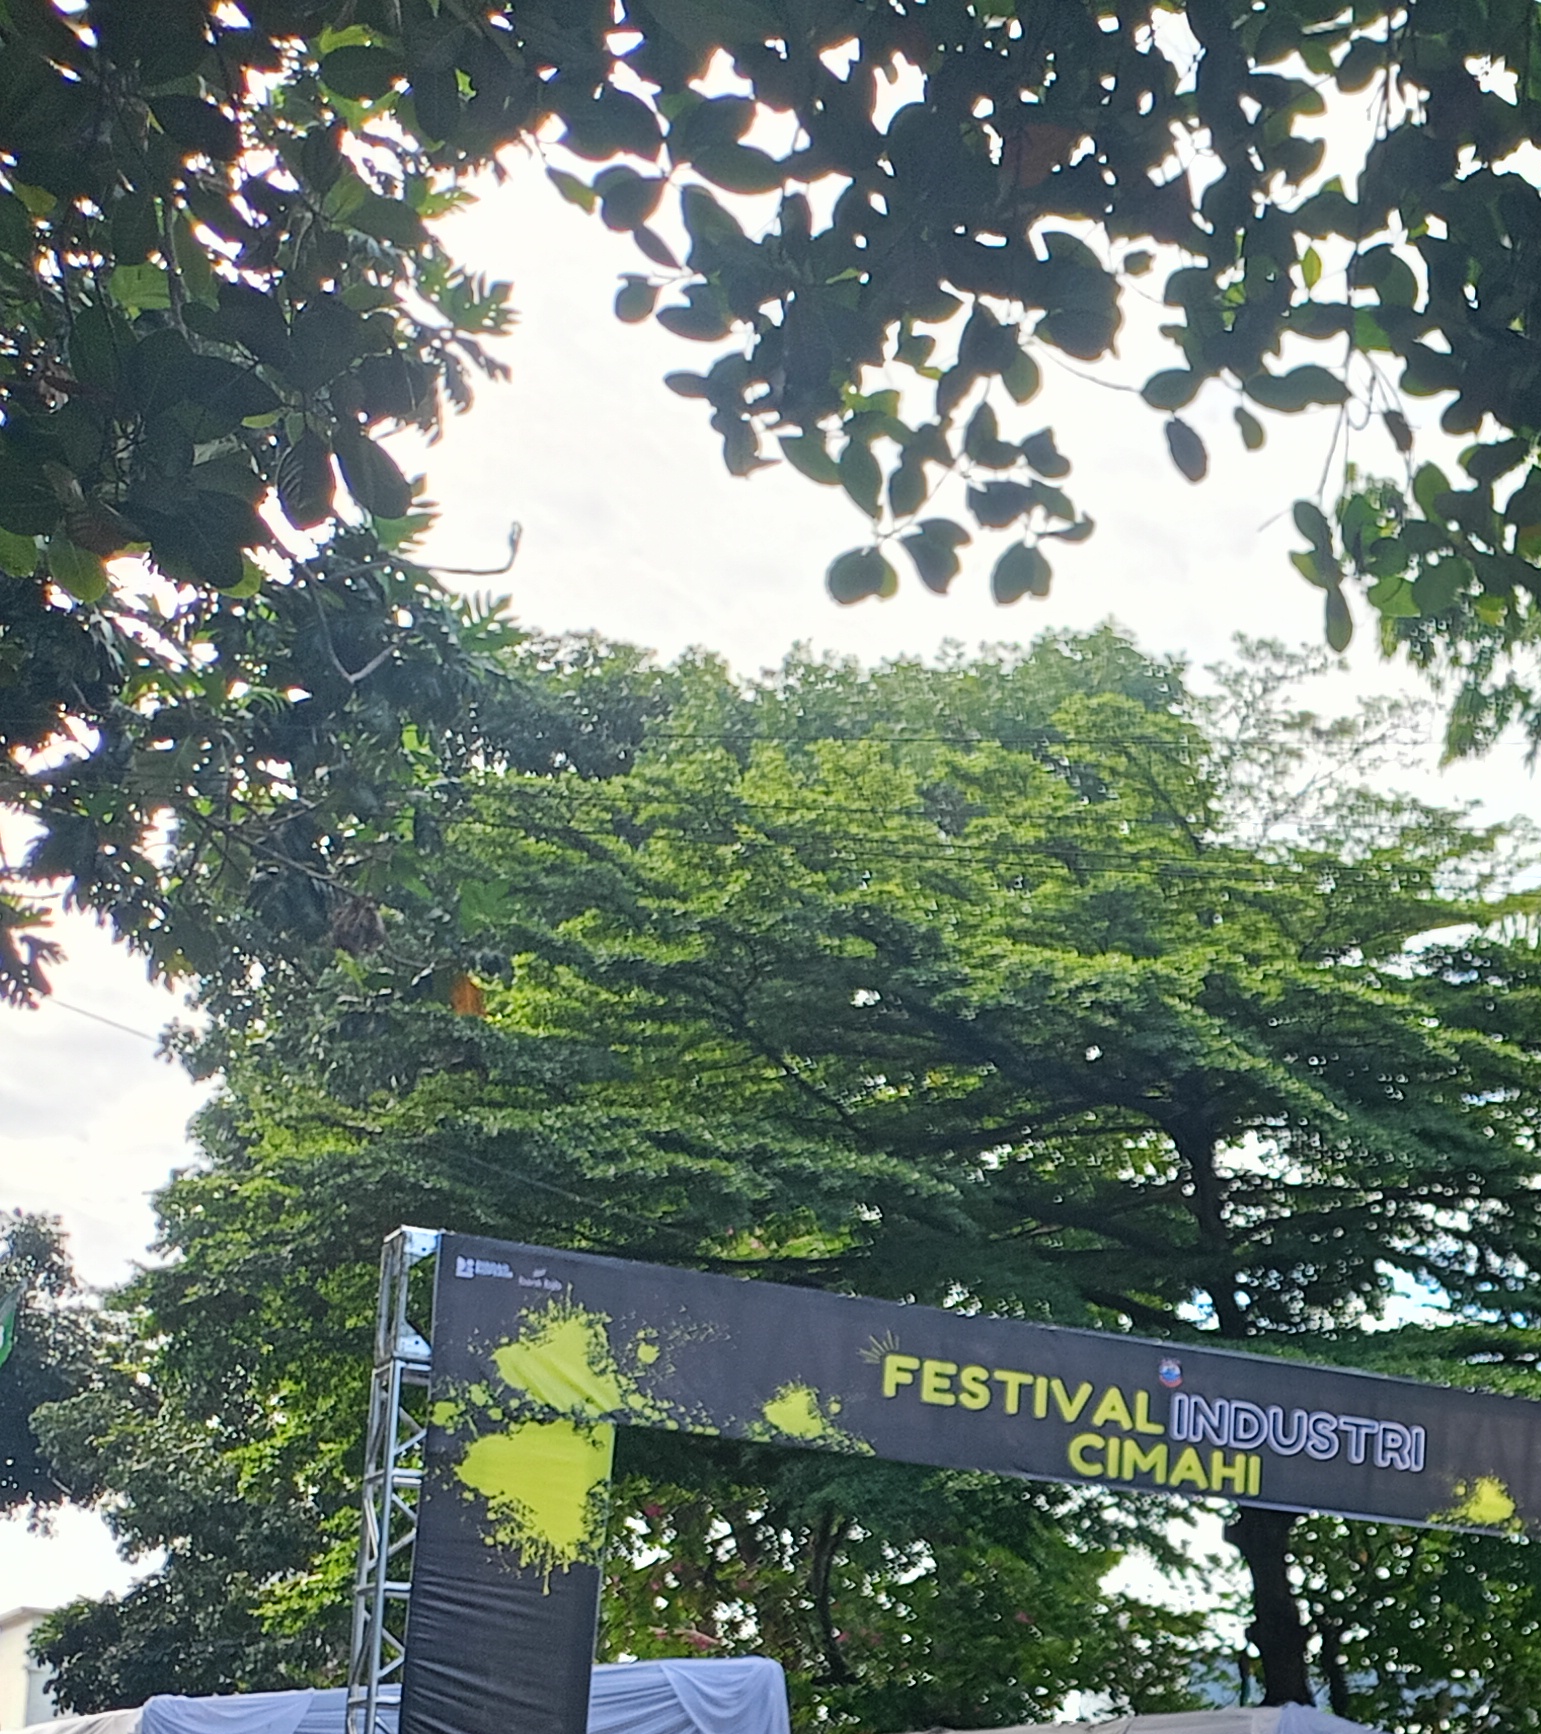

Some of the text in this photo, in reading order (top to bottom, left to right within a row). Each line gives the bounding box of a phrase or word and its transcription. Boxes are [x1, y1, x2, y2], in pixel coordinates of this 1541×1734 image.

[881, 1353, 1426, 1473] FESTIVAL INDUSTRI
[1069, 1432, 1263, 1496] CIMAHI
